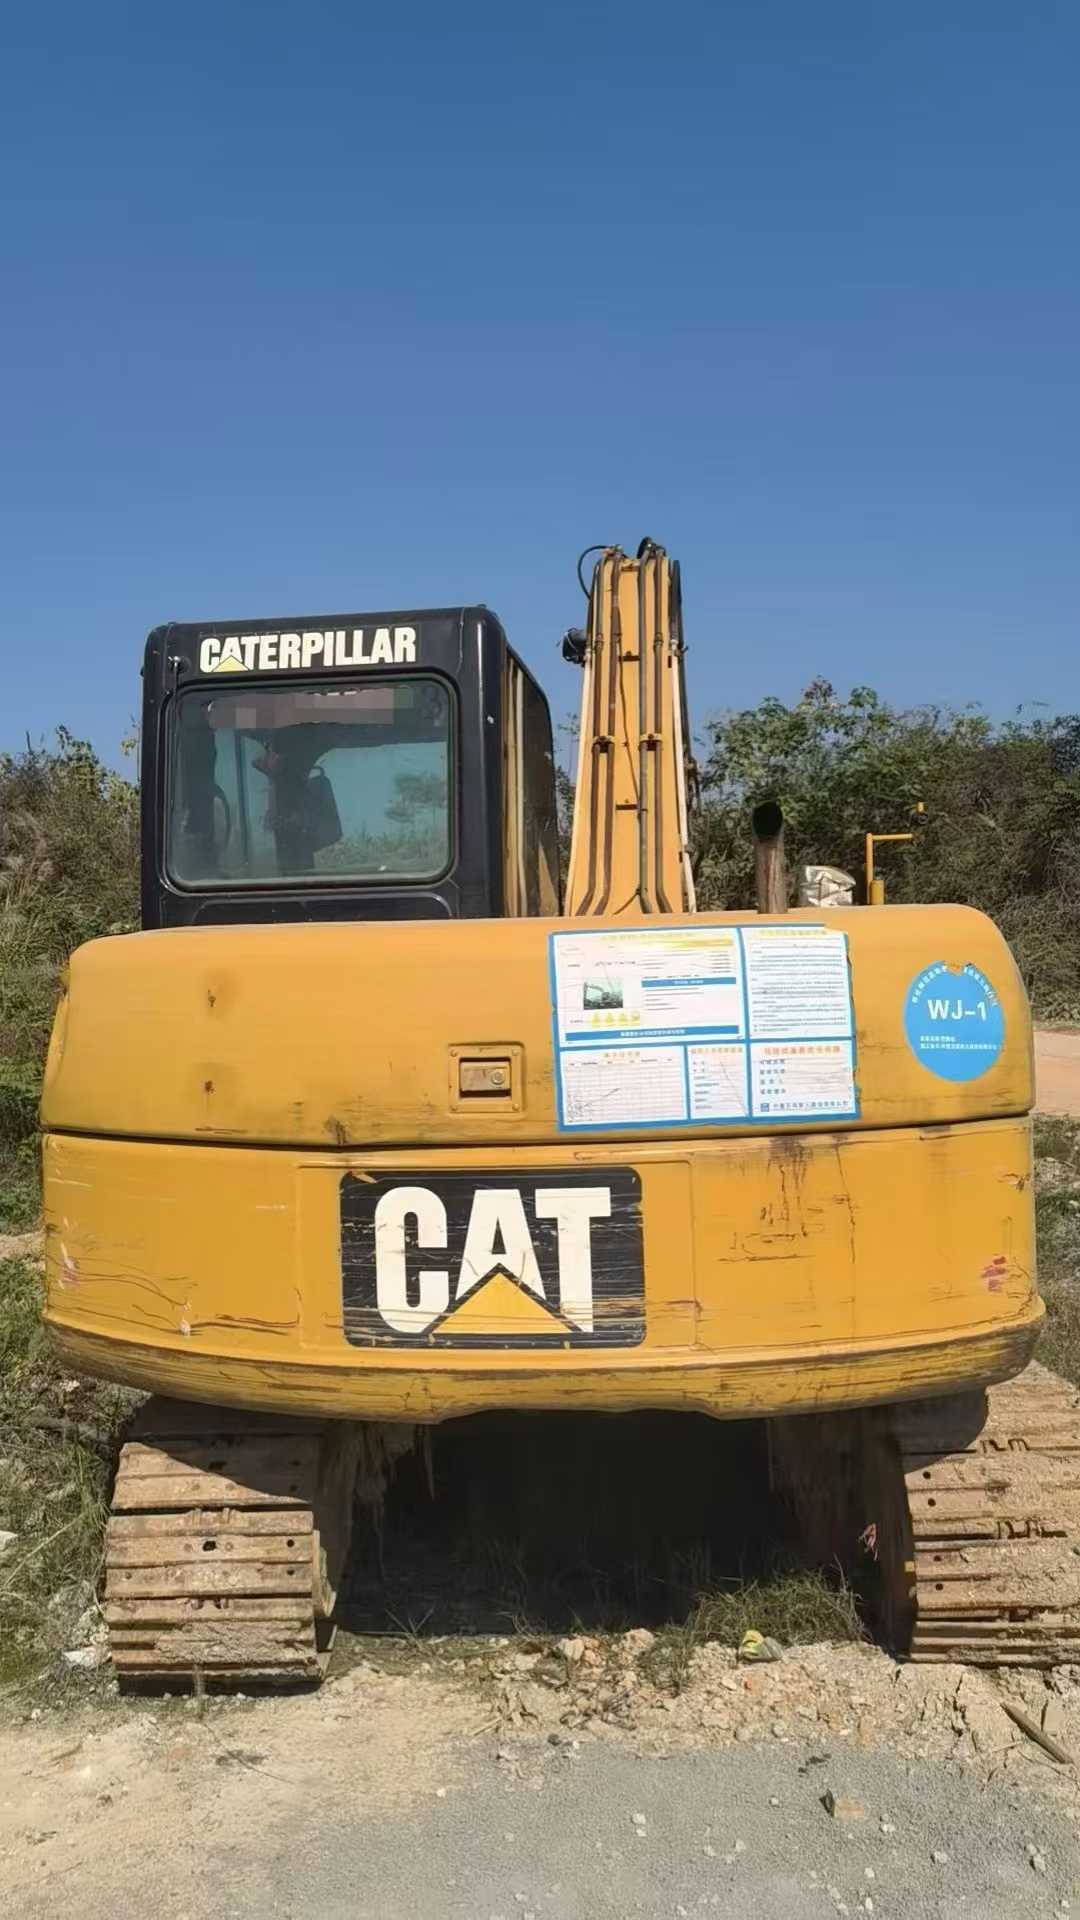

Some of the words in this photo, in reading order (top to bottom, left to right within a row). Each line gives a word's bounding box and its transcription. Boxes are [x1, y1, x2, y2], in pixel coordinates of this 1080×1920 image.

[200, 627, 416, 673] CATERPILLAR
[927, 999, 987, 1021] WJ-1
[374, 1186, 612, 1335] CAT
